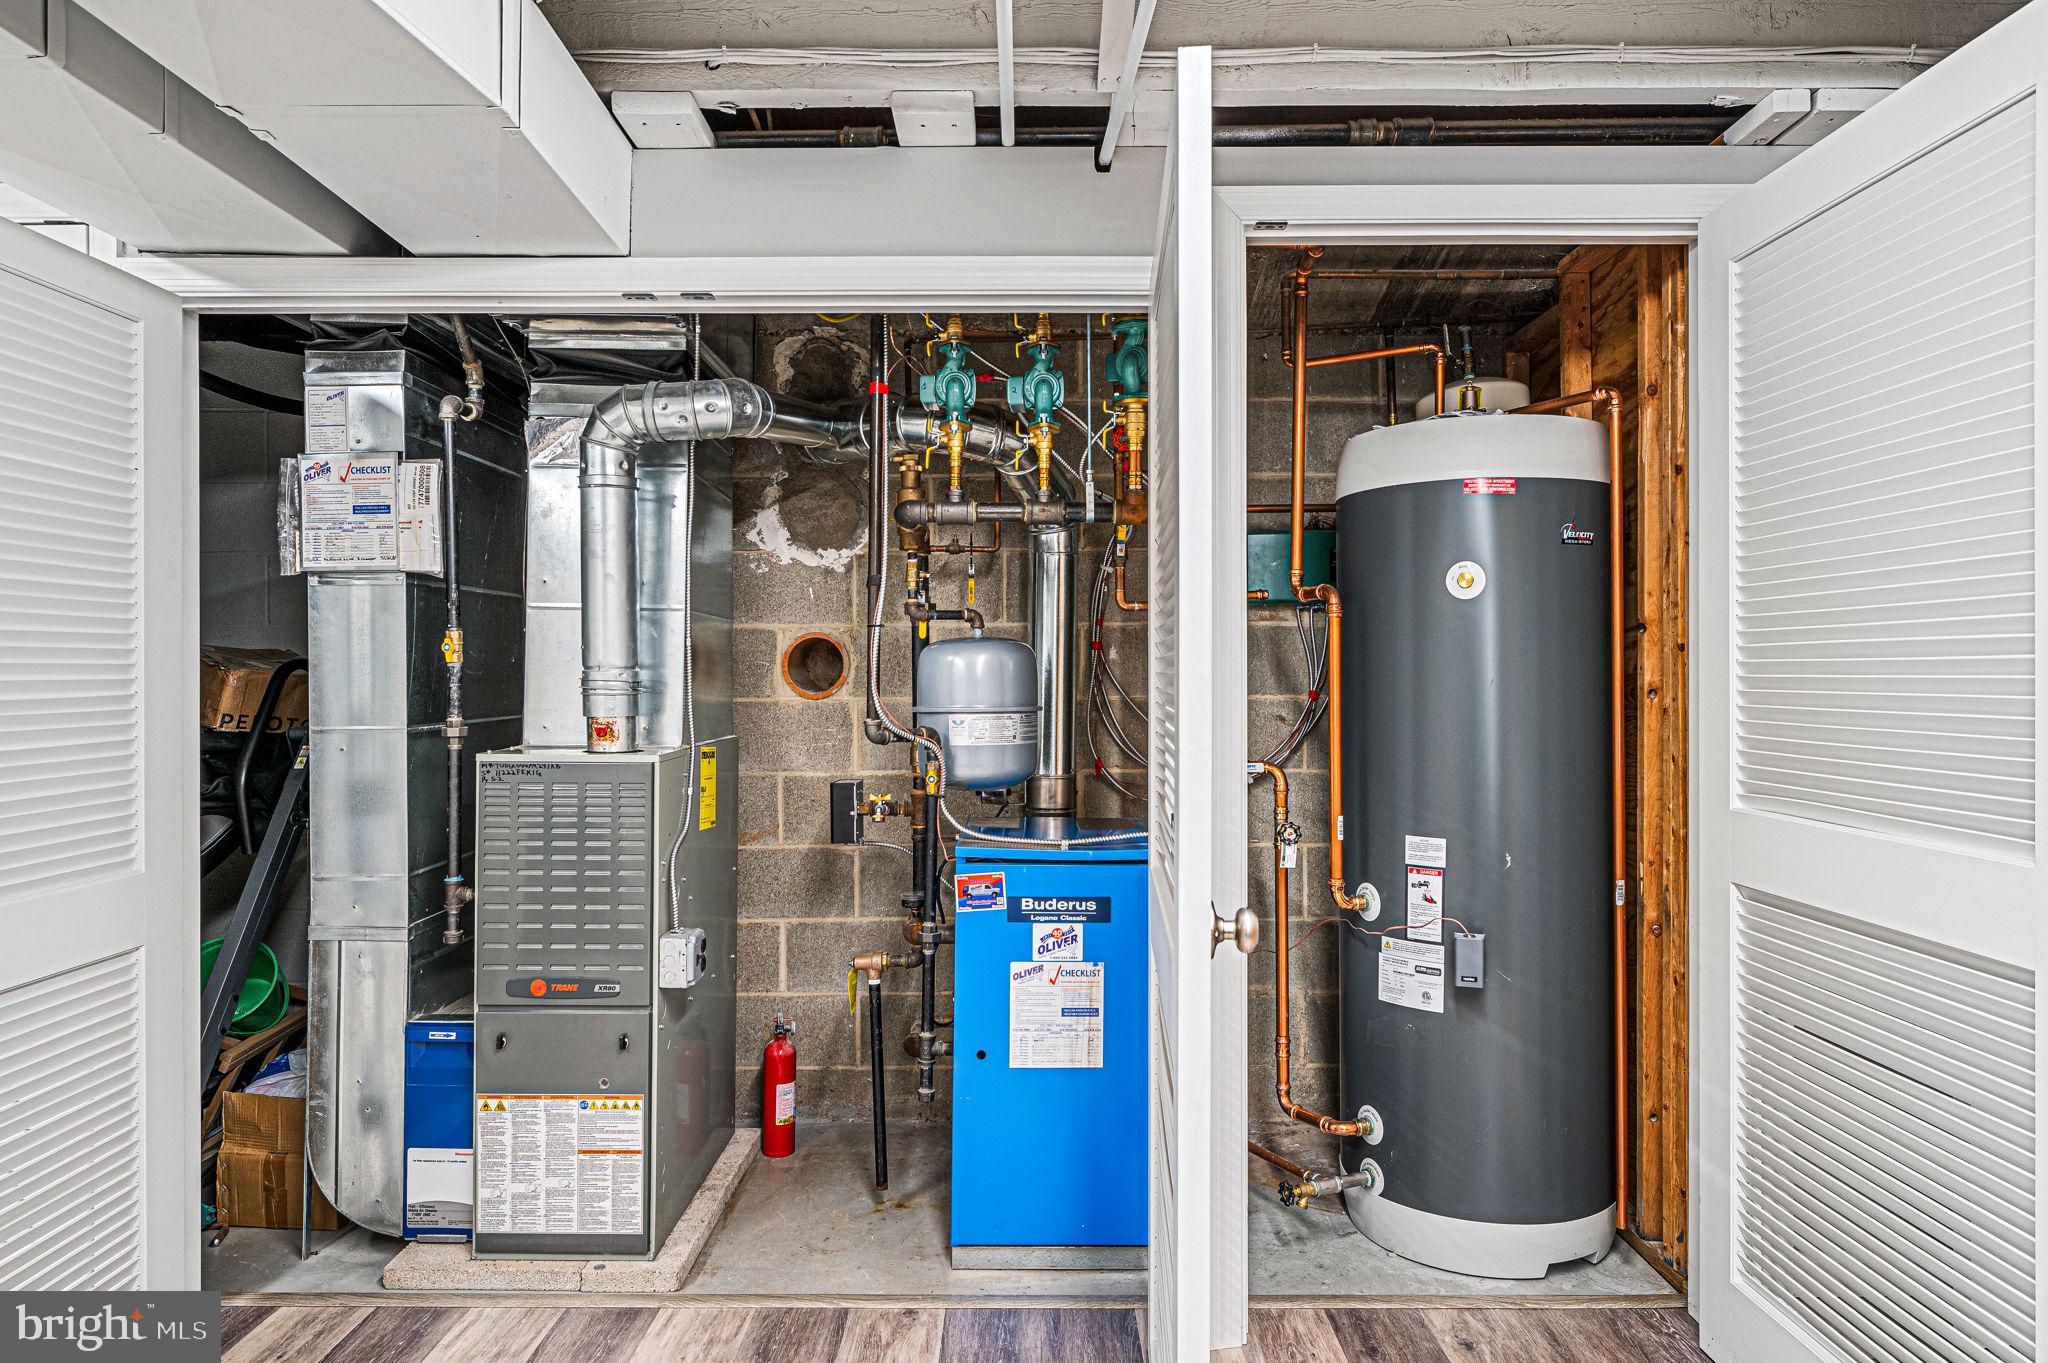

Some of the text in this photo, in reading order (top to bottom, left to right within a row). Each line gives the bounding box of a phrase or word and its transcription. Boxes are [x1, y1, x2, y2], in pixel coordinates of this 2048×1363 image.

[326, 390, 345, 401] OLIVER
[304, 466, 332, 482] OLIVER
[351, 466, 392, 475] CHECKLIST
[1021, 897, 1097, 911] Buderus
[1030, 914, 1058, 922] Logano
[1037, 934, 1079, 956] OLIVER
[1012, 964, 1101, 982] OLIVER CHECKLIST
[550, 984, 579, 992] TRANE
